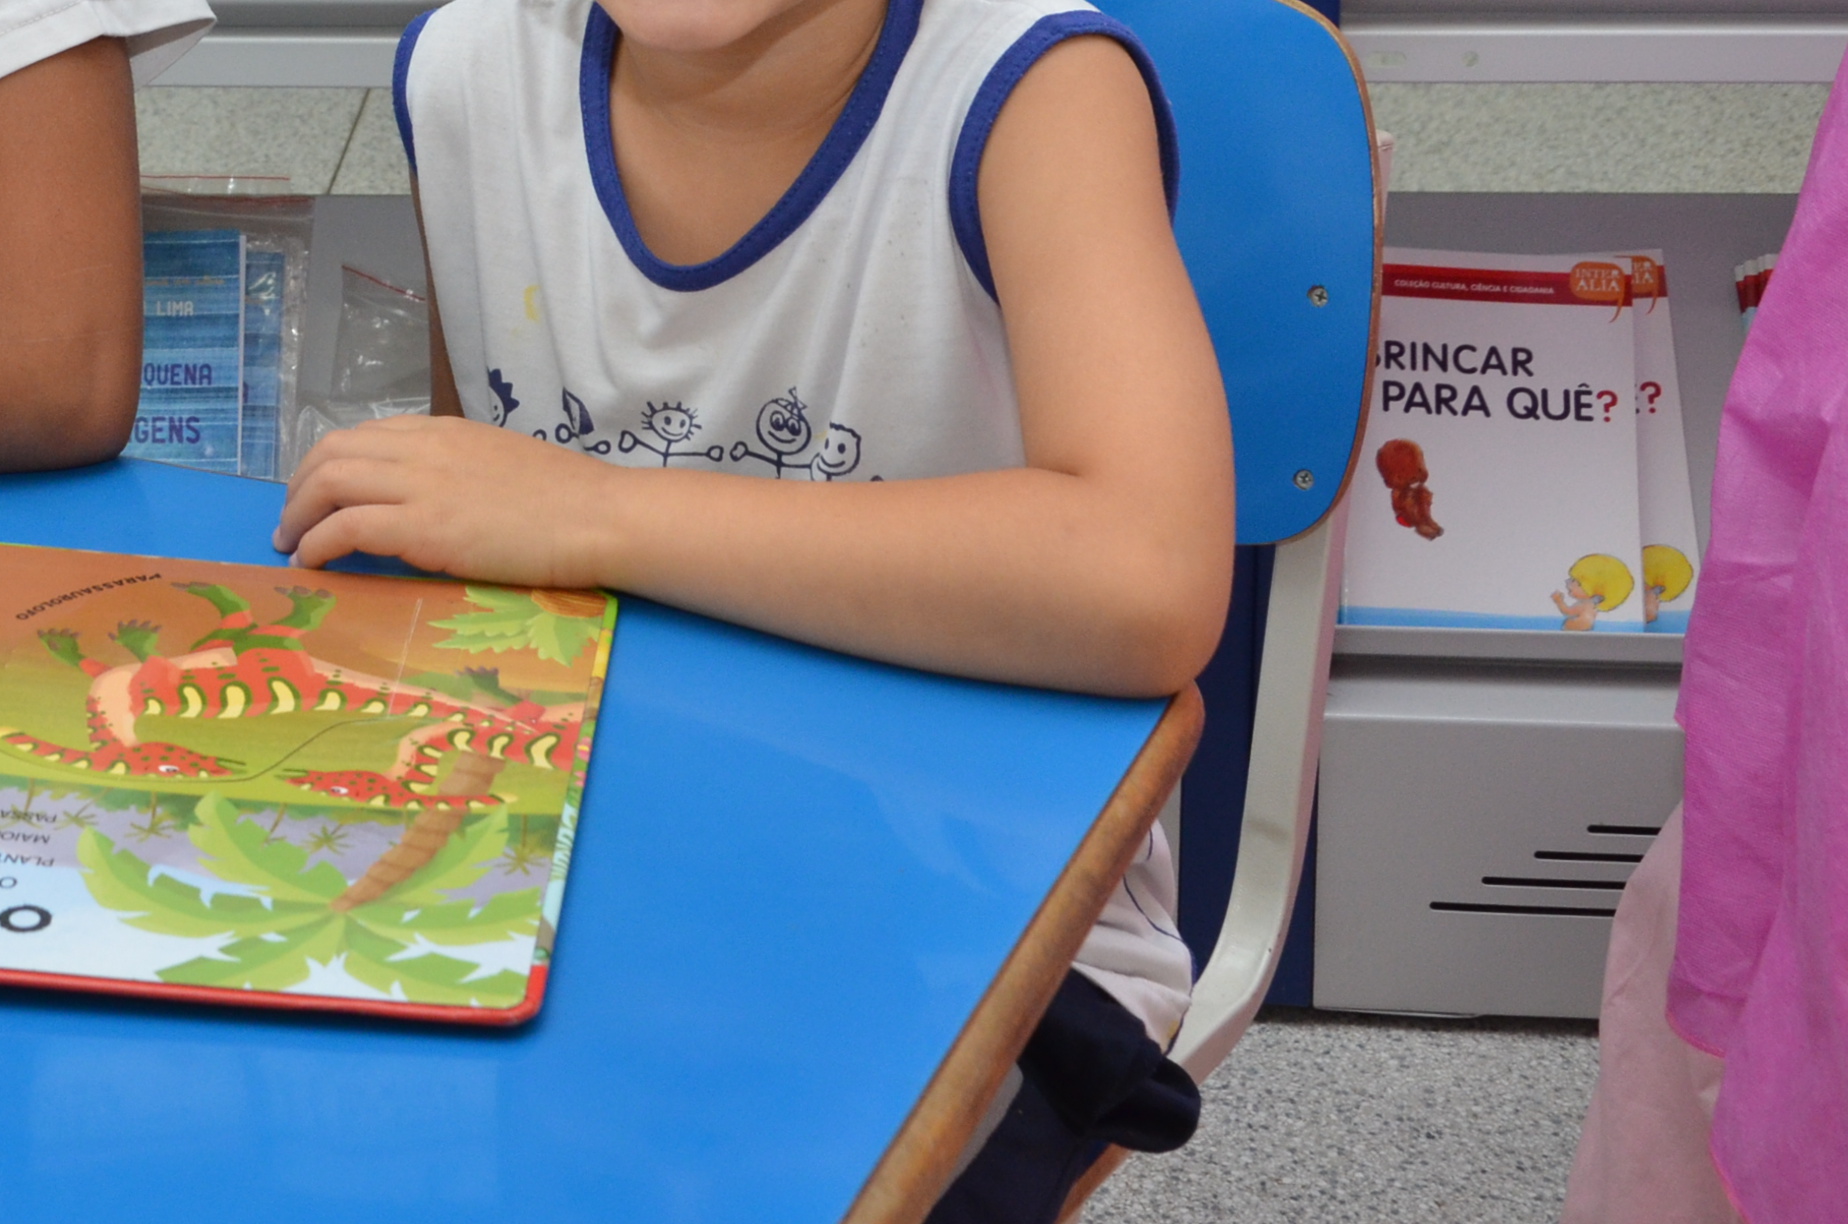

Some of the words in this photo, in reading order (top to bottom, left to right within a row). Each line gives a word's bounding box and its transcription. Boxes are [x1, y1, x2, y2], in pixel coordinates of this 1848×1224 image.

[1575, 267, 1621, 280] INTER
[1575, 279, 1621, 293] ALIA
[156, 301, 194, 317] LIMA
[1375, 340, 1534, 377] RINCAR
[1381, 380, 1491, 418] PARA
[1506, 383, 1619, 423] QUÊ?
[129, 416, 200, 444] GENS
